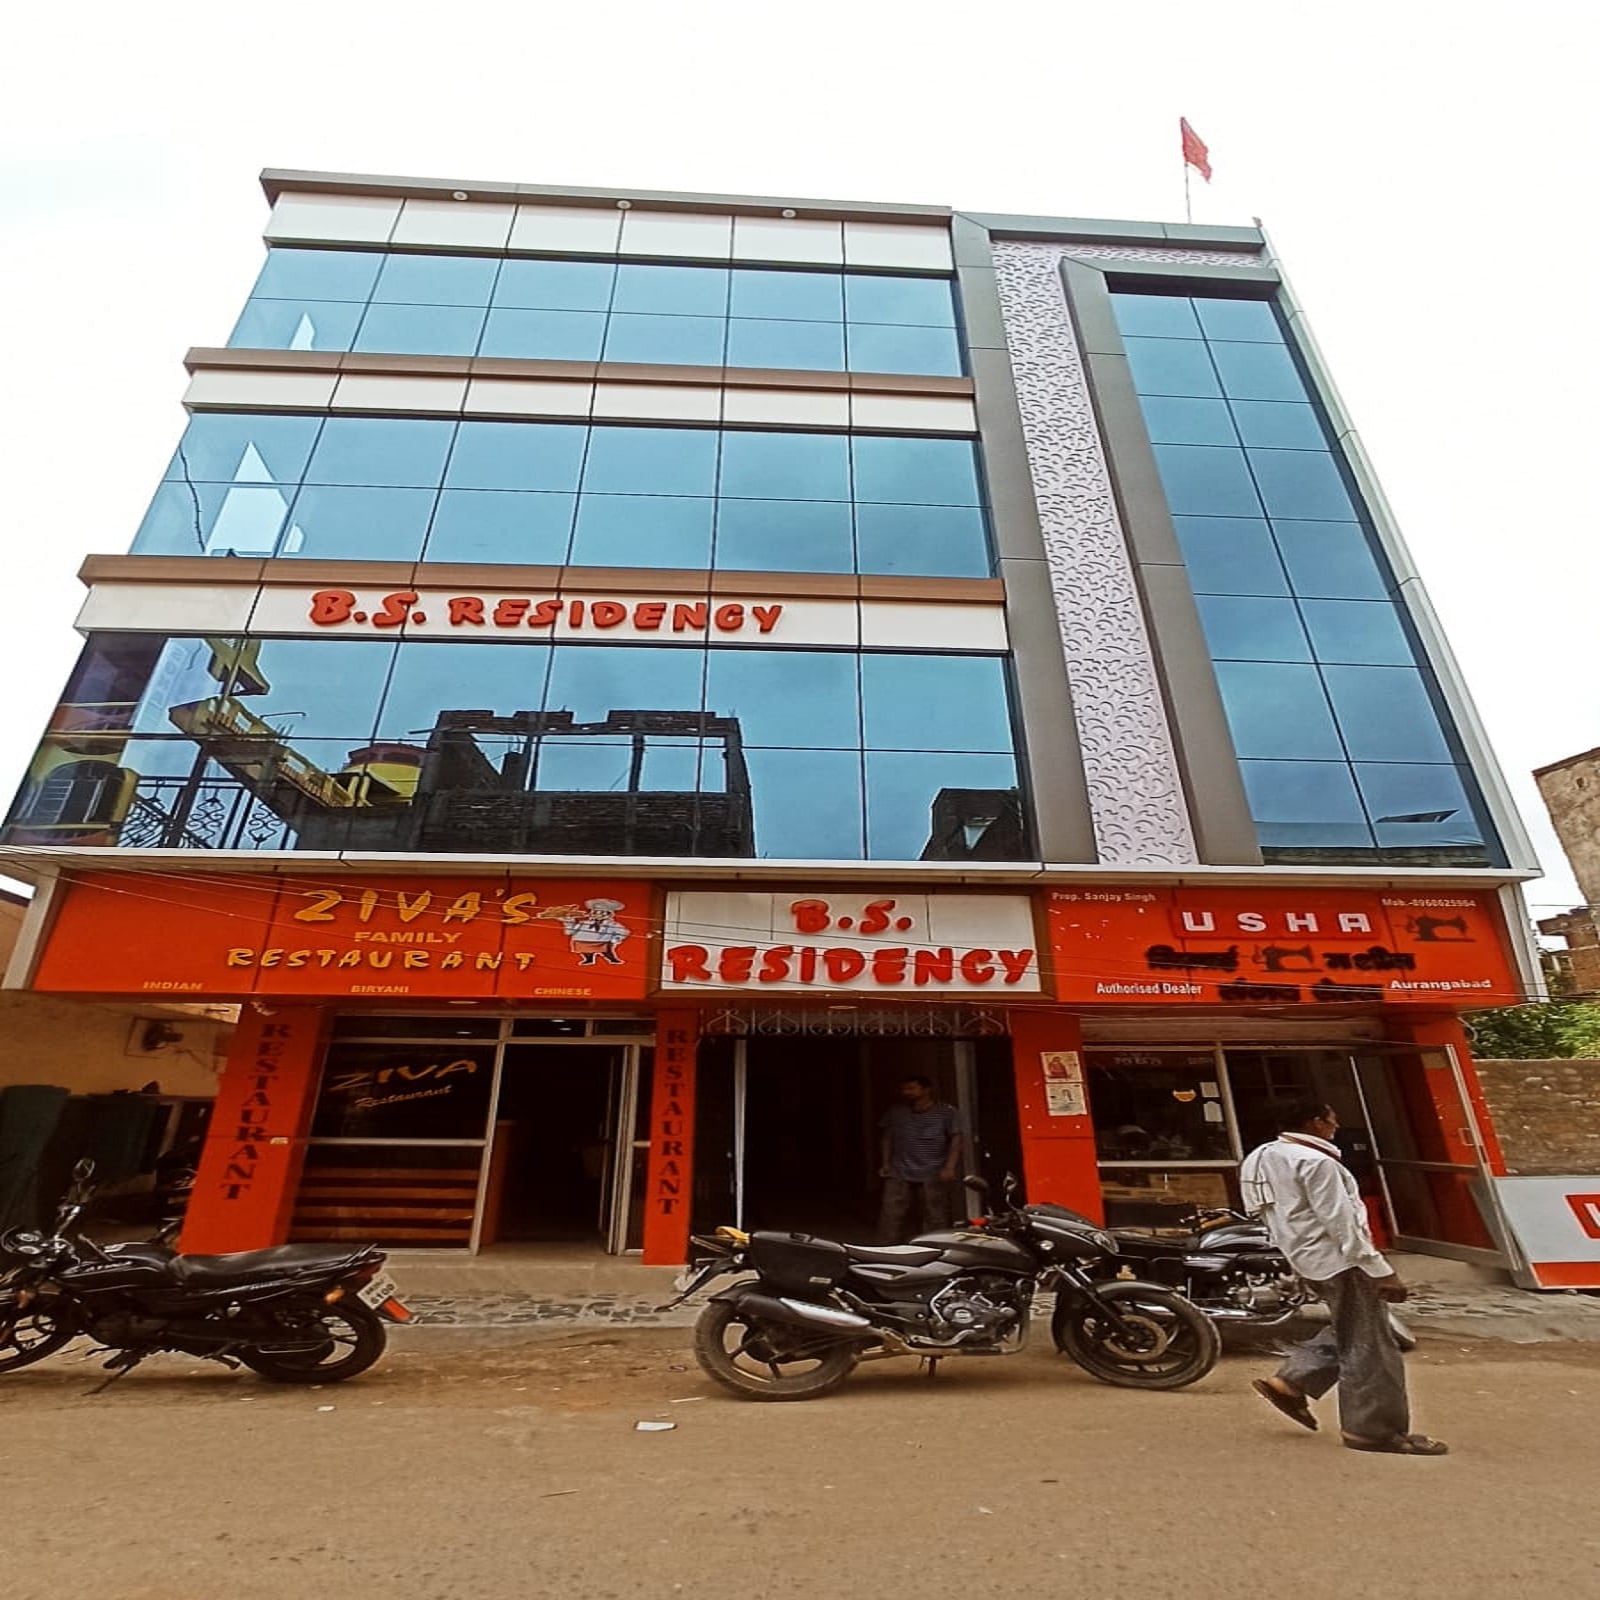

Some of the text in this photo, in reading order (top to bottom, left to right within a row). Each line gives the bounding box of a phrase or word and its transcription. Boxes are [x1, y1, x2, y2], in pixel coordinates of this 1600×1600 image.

[309, 589, 783, 635] B.S. RESIDENCY
[294, 889, 538, 924] ZIVA'S
[1084, 892, 1122, 902] Sanjay
[790, 898, 914, 934] B.S.
[1182, 911, 1373, 934] USHA
[354, 931, 464, 944] FAMILY
[226, 947, 536, 971] RESTAURANT
[667, 945, 1035, 986] RESIDENCY
[143, 981, 204, 991] INDIAN
[351, 985, 410, 994] BIRYANI
[534, 987, 592, 996] CHINESE
[1096, 982, 1203, 995] Authorised Dealer
[1390, 979, 1493, 992] Aurangabad
[330, 1060, 478, 1091] ZIVA
[219, 1023, 293, 1201] RESTAURANT
[657, 1029, 688, 1216] RESTAURANT
